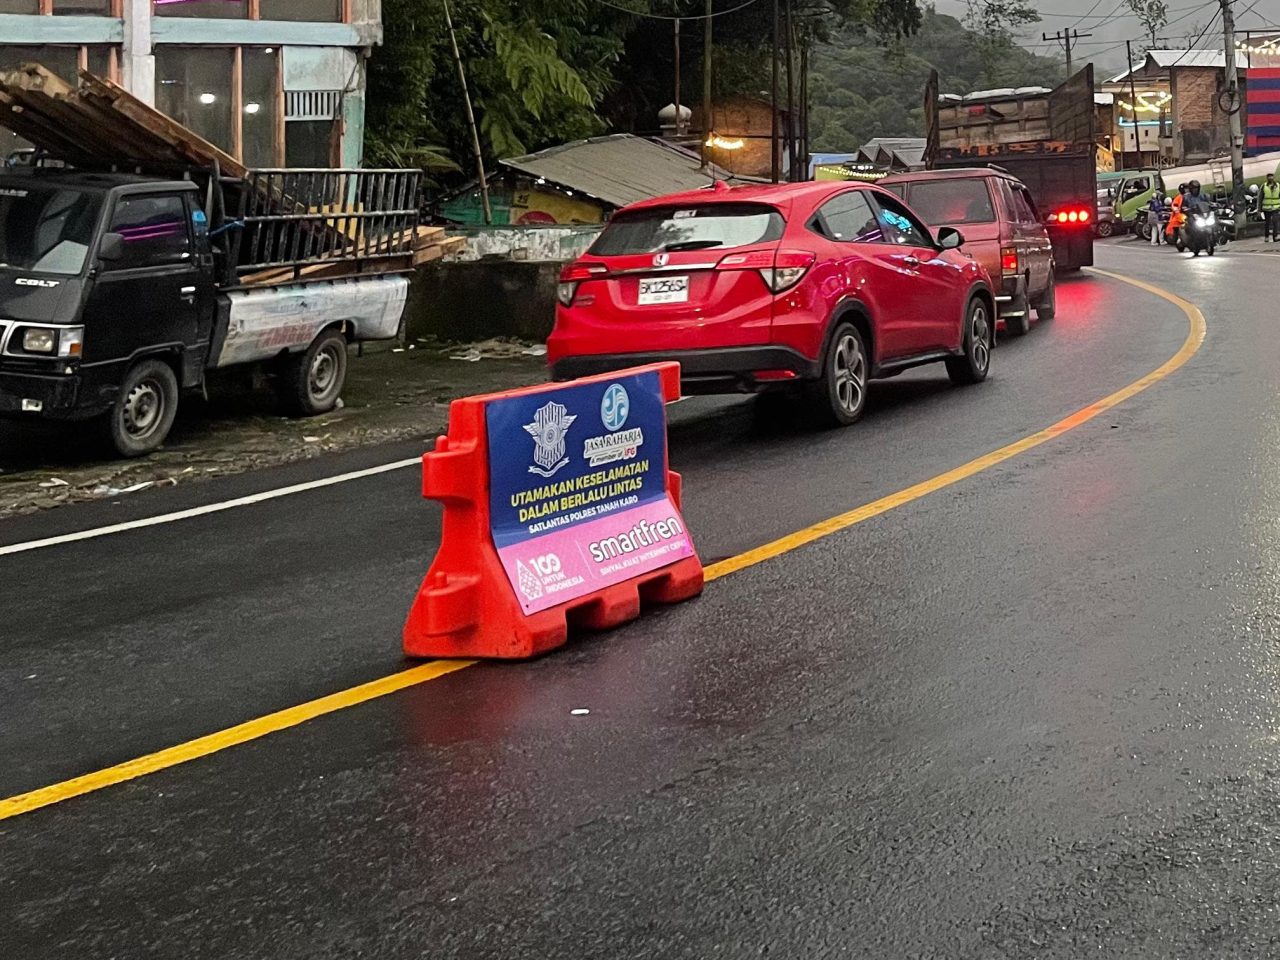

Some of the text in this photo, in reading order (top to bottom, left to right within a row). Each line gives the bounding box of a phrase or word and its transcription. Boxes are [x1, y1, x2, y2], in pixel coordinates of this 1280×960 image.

[15, 278, 60, 288] COLT
[585, 431, 642, 454] JASA RAHARJA
[511, 460, 649, 507] UTAMAKAN KESELAMATAN
[519, 477, 643, 523] DALAM BERLALU LINTAS
[528, 495, 639, 534] SATLANTAS POLRES TANAH KARO
[589, 516, 683, 562] smartfren
